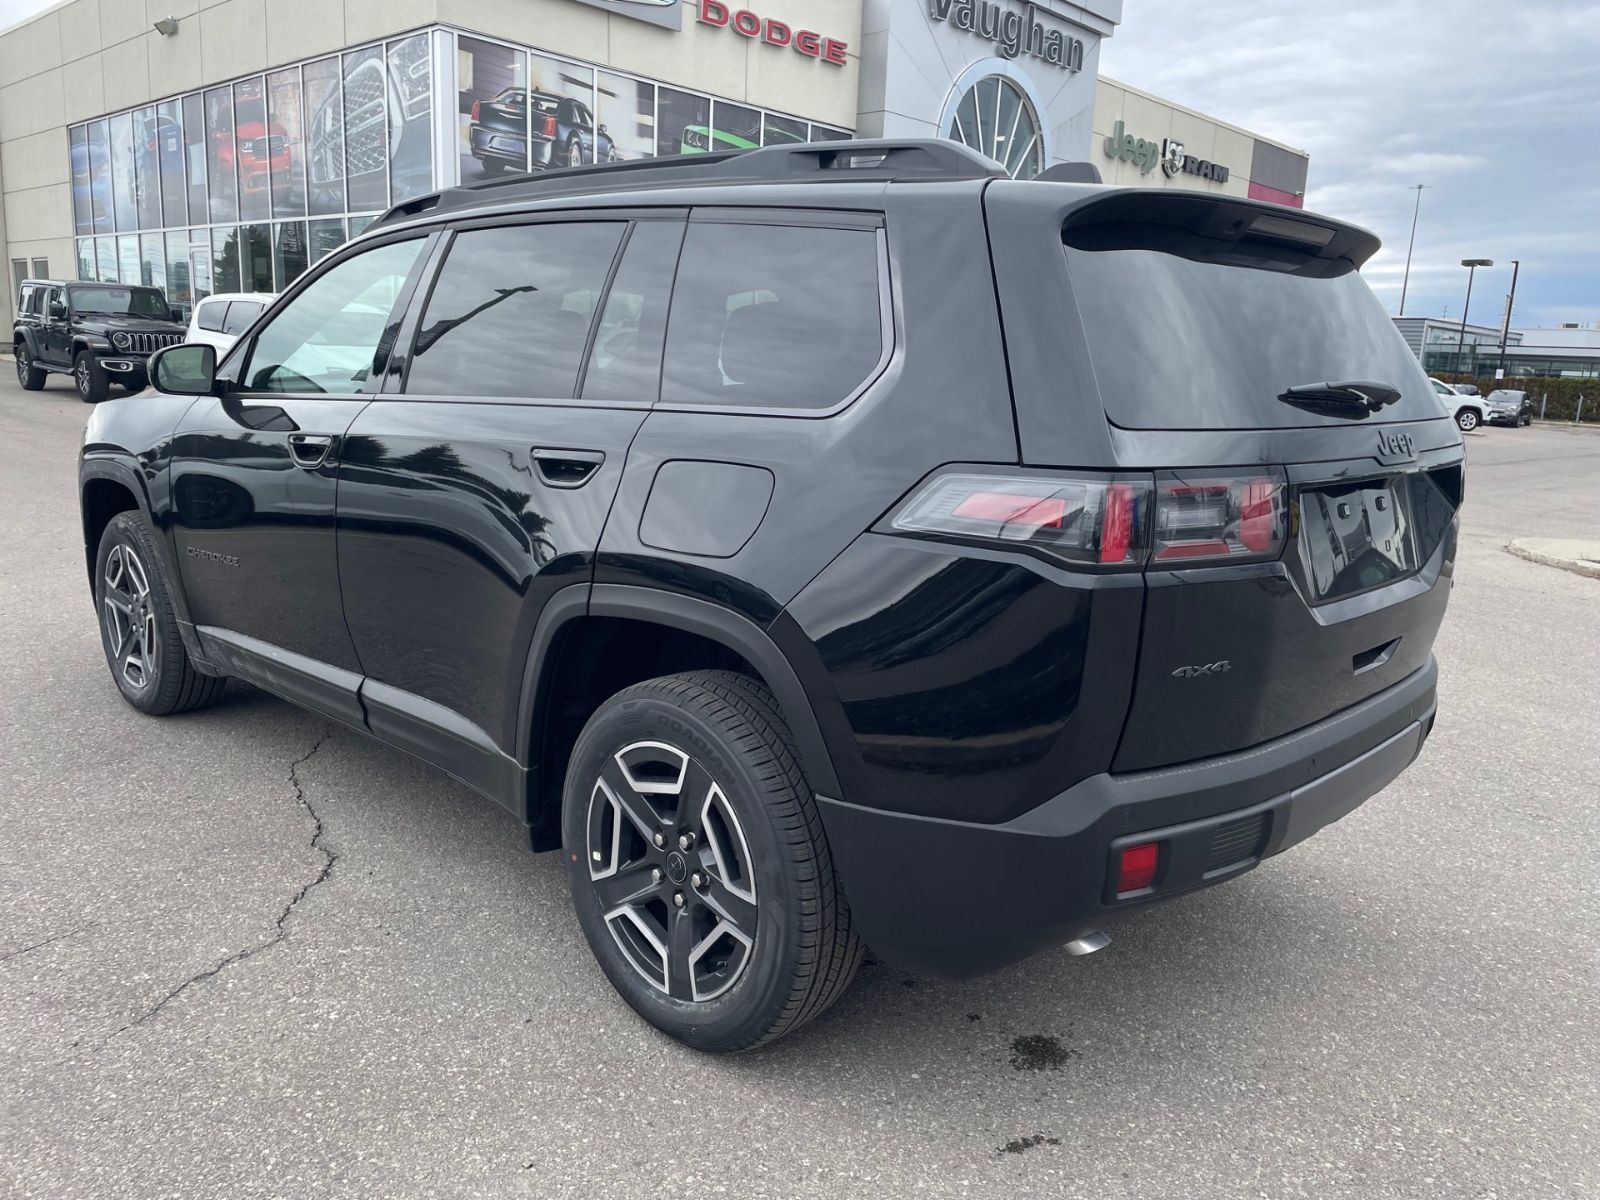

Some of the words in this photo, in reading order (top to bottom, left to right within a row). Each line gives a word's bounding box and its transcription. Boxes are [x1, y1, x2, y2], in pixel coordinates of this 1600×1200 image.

[696, 0, 848, 67] DODGE
[1104, 120, 1159, 175] Jeep
[1182, 155, 1229, 183] RAM
[1377, 430, 1414, 459] Jeep
[186, 546, 240, 568] CHEROKEE
